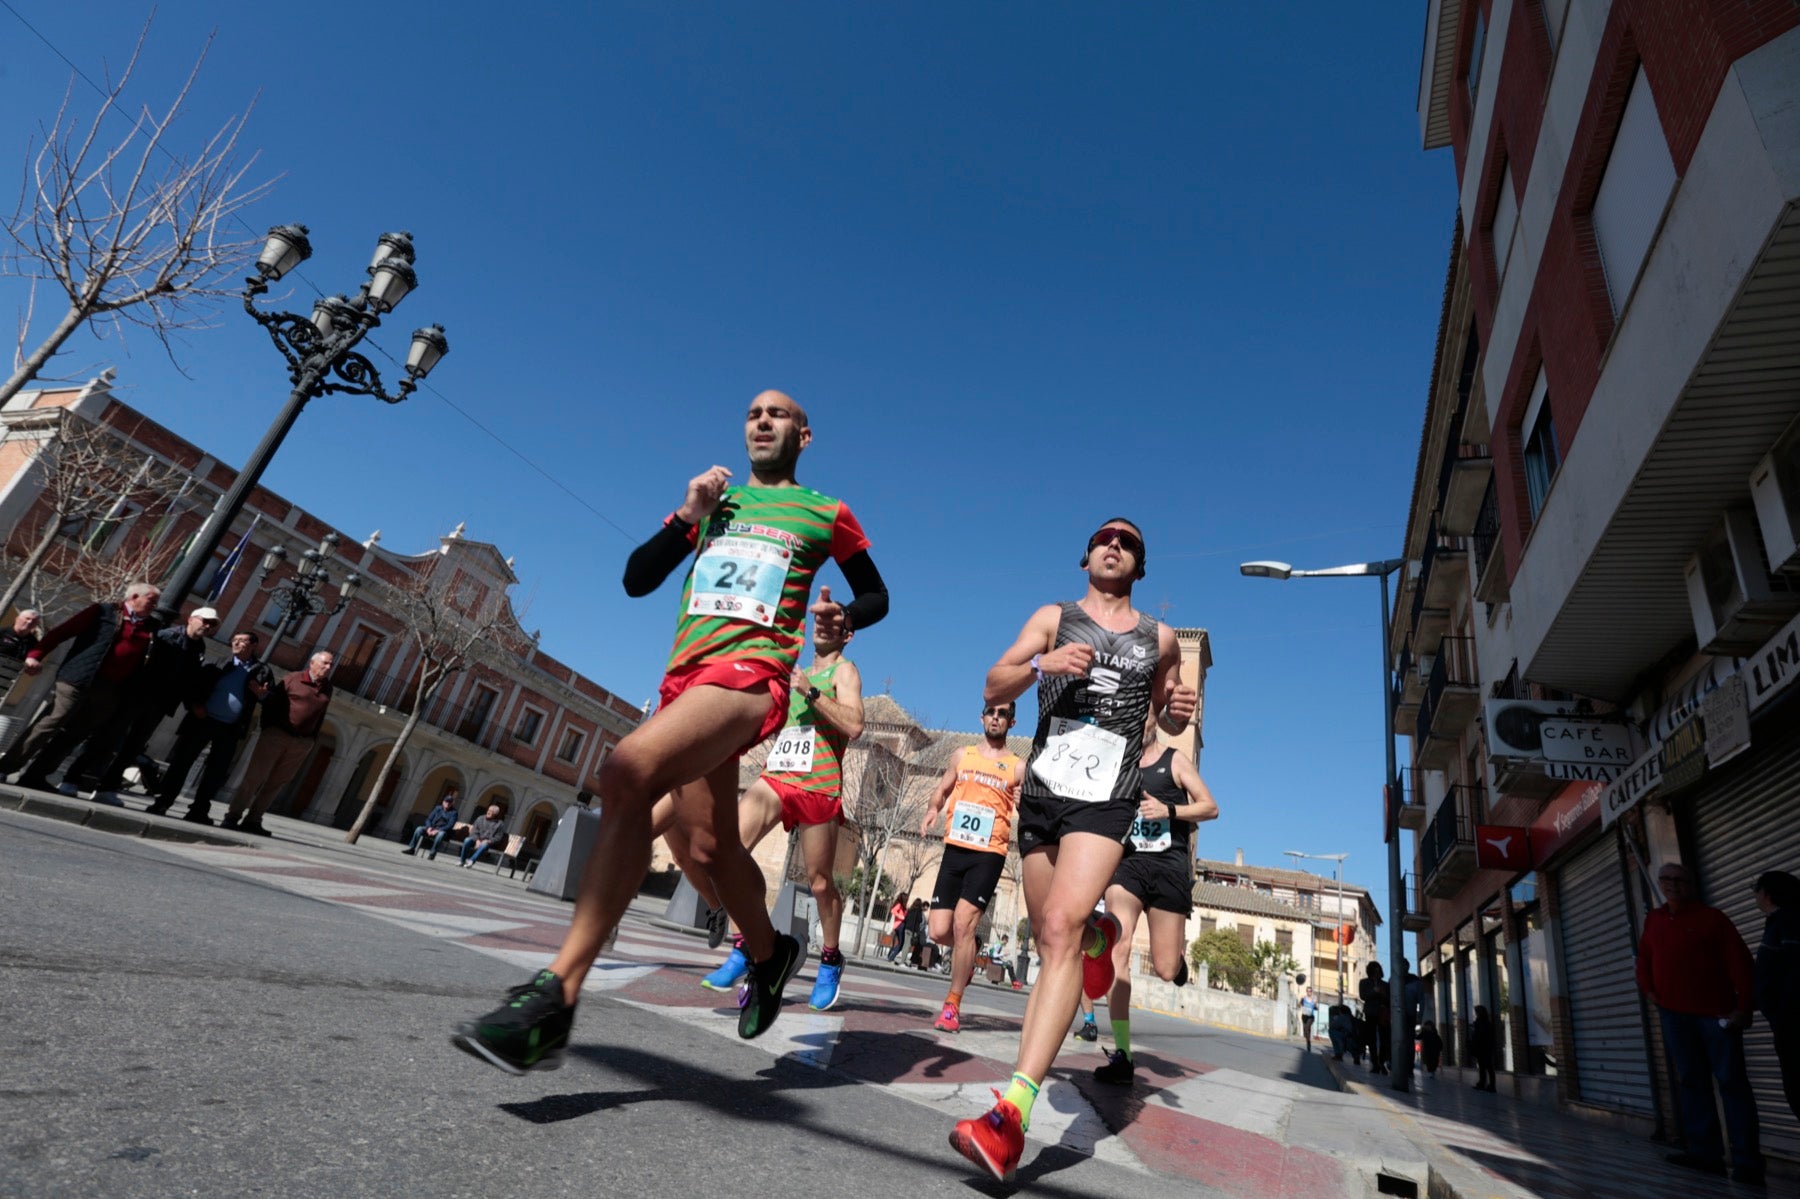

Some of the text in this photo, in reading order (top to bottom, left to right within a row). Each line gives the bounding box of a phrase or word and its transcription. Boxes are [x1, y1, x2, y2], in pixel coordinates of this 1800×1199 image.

[715, 561, 759, 592] 24
[1544, 727, 1603, 740] CAFÉ
[1584, 746, 1629, 759] BAR
[1550, 763, 1612, 781] LIMA
[961, 814, 980, 832] 20
[1132, 821, 1162, 837] 852
